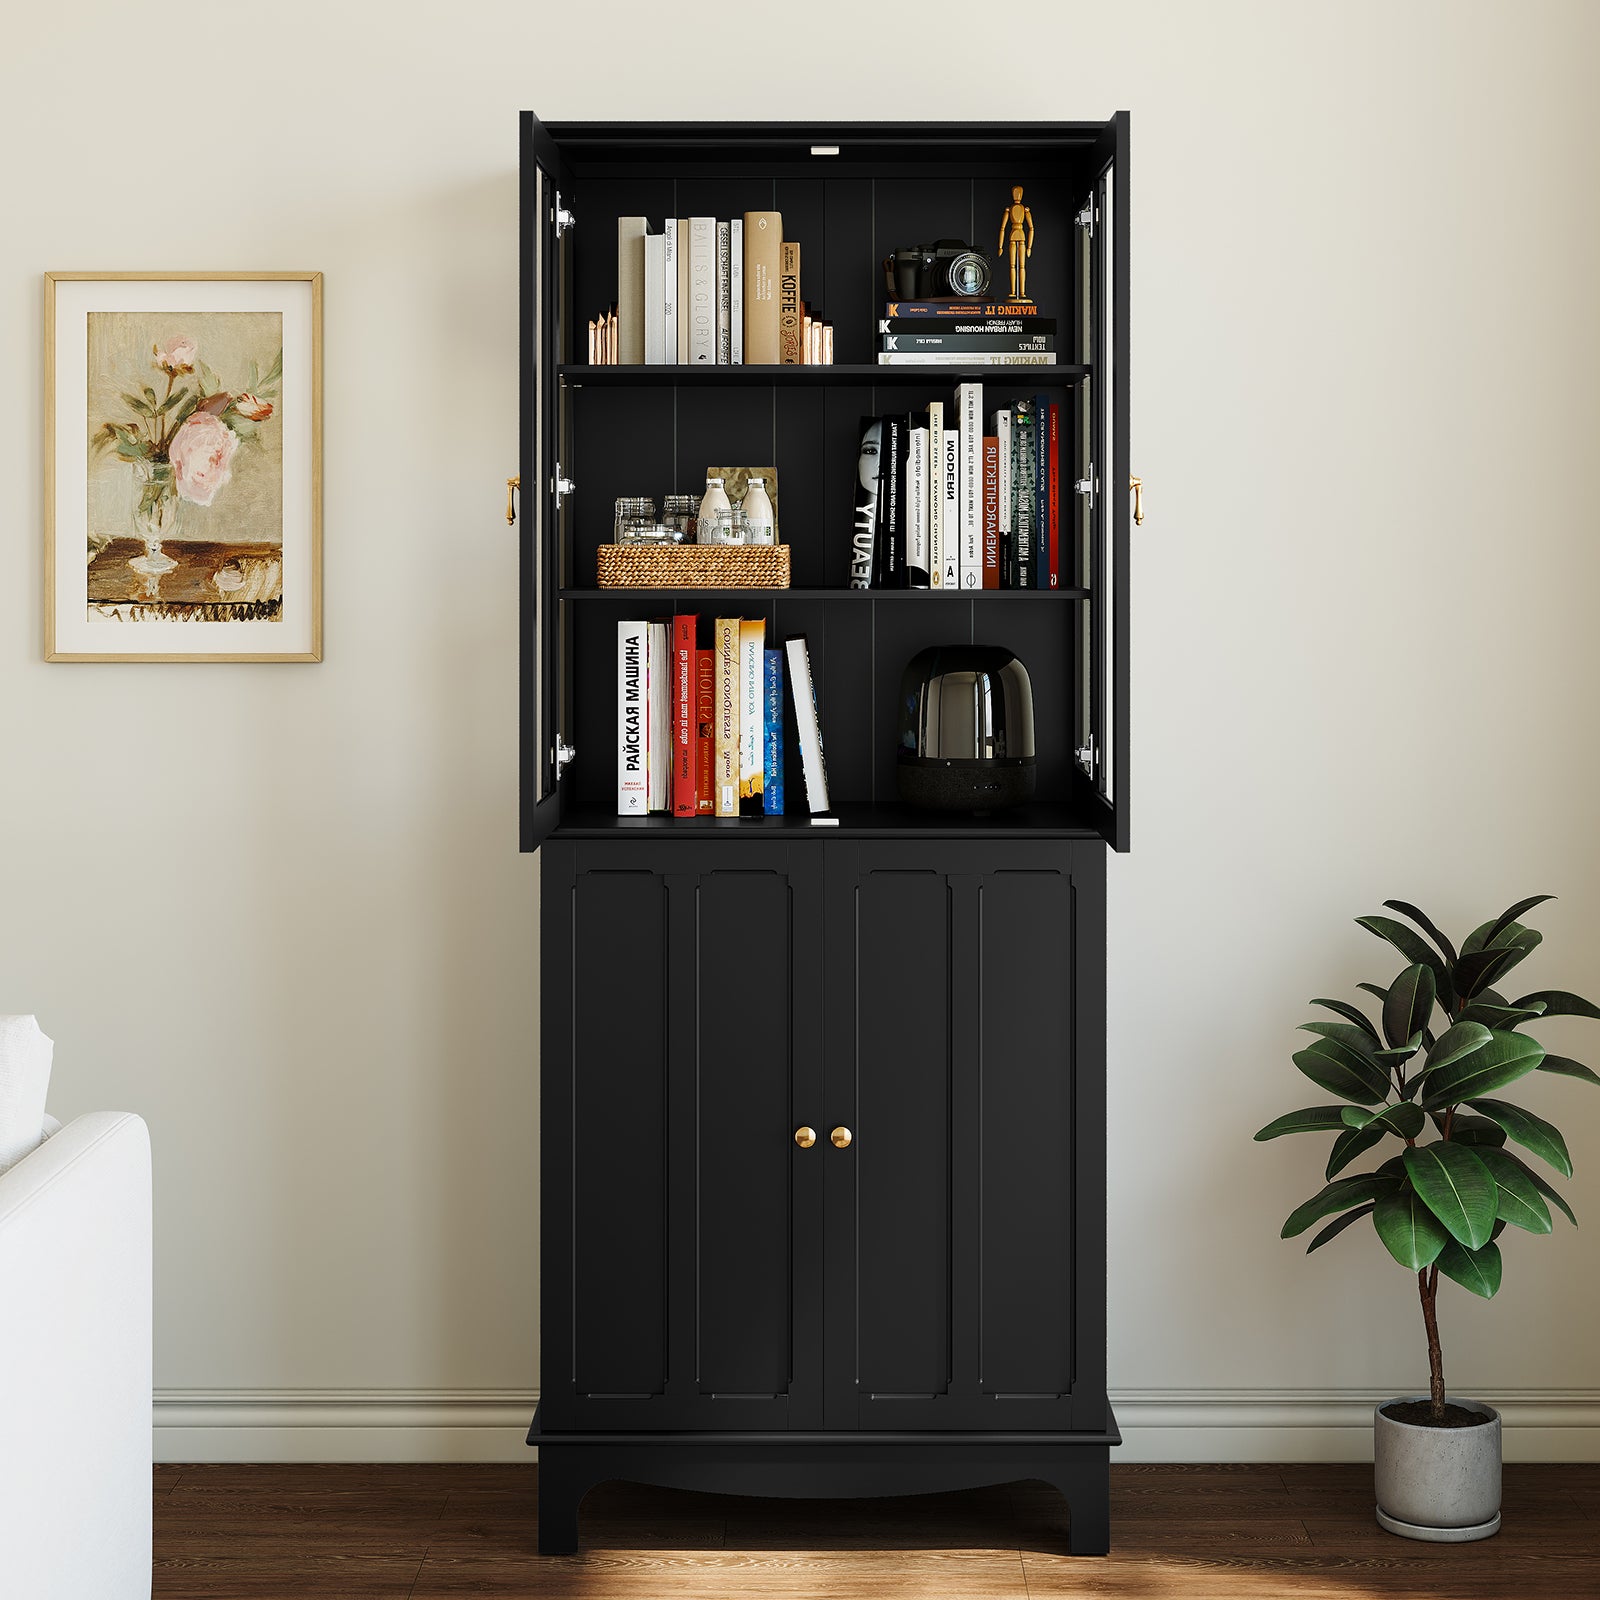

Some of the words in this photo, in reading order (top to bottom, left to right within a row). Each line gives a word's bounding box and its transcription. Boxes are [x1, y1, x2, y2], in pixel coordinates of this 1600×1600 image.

[781, 275, 797, 313] KOFFIE
[985, 305, 996, 315] IT
[998, 305, 1038, 315] MAKING
[695, 293, 709, 347] GLORY
[955, 325, 984, 333] HOUSING
[985, 325, 1007, 333] URBAN
[1007, 325, 1023, 333] NEW
[1018, 343, 1046, 351] TEXTILES
[625, 635, 640, 701] МАШИНА
[622, 706, 640, 771] РАЙСКАЯ
